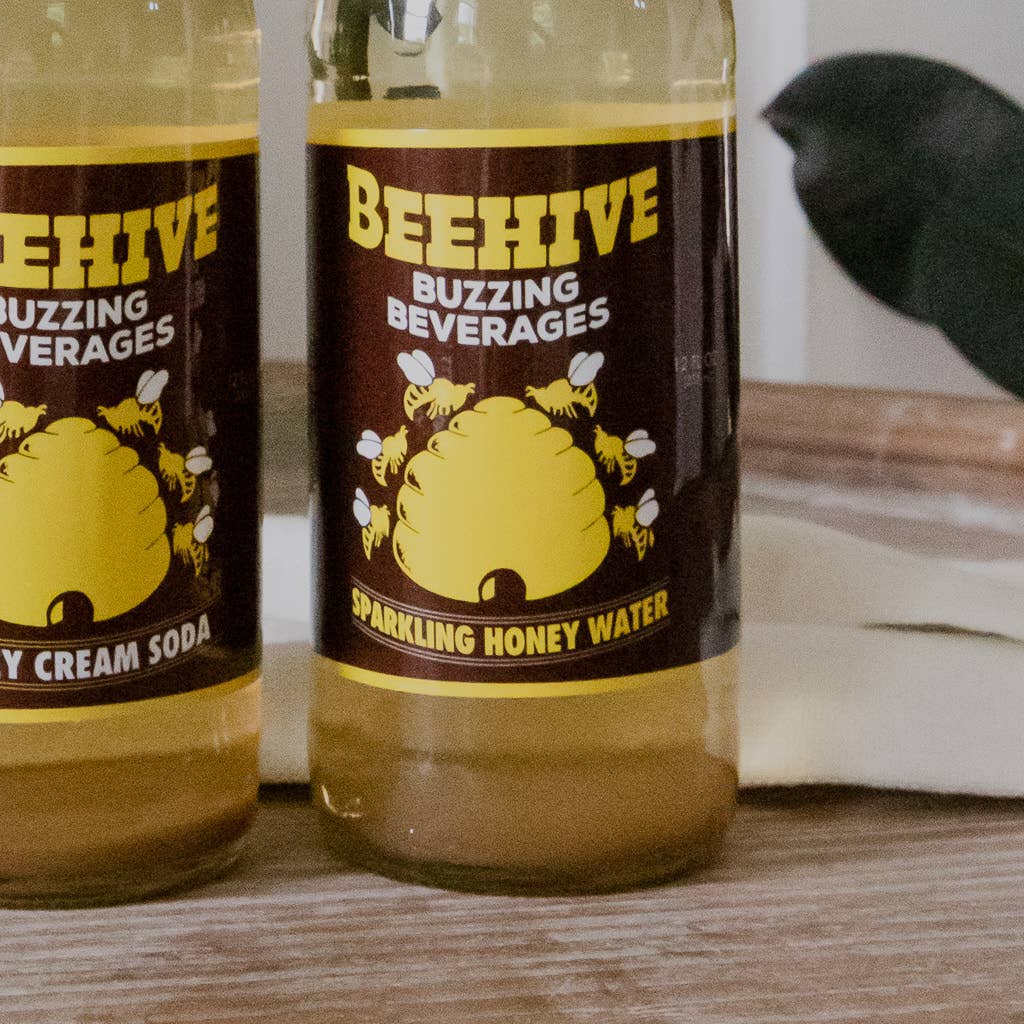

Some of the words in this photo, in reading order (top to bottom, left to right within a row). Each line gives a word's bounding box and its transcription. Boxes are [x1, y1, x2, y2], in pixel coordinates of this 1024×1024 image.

[347, 164, 658, 270] BEEHIVE
[387, 296, 609, 346] BEVERAGES
[413, 272, 579, 312] BUZZING
[34, 641, 139, 681] CREAM
[148, 613, 211, 665] SODA
[351, 588, 475, 655] SPARKLING
[484, 620, 580, 656] HONEY
[588, 589, 669, 644] WATER
